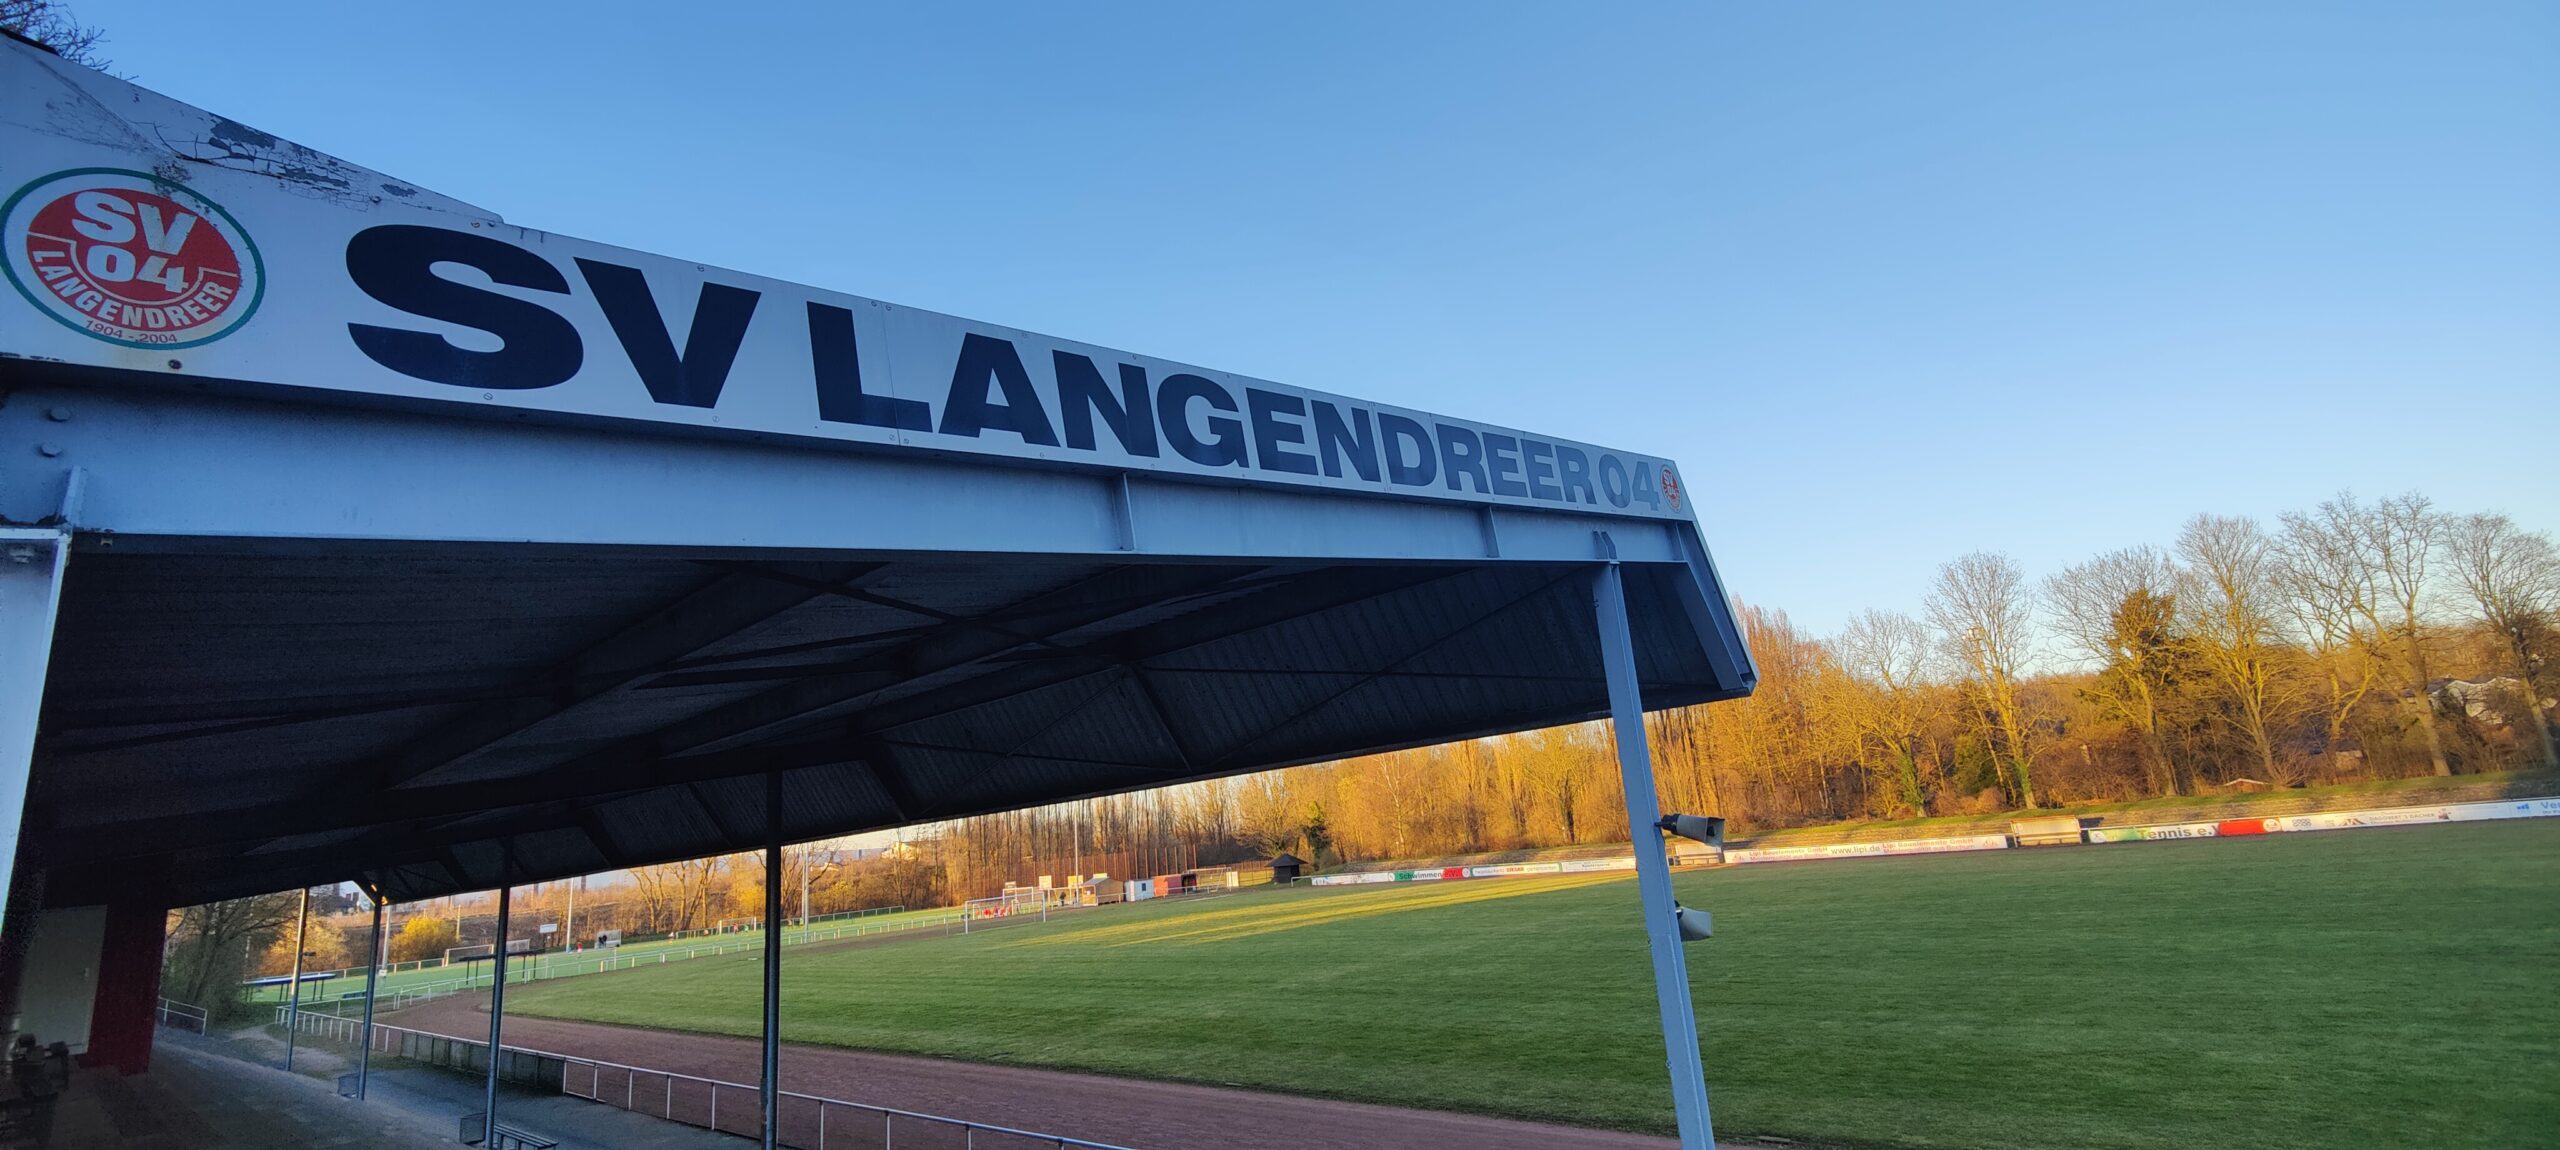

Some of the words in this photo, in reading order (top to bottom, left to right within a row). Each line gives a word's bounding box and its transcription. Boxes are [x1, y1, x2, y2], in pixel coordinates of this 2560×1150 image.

[72, 190, 198, 256] SV
[86, 244, 189, 293] 04
[32, 249, 233, 329] LANGENDREER
[86, 319, 123, 339] 1904
[138, 332, 177, 344] 2004
[346, 224, 762, 408] SV
[806, 301, 1598, 504] LANGENDREER
[1599, 453, 1661, 512] 04
[1830, 844, 1880, 856] www.lipi.de
[2137, 826, 2191, 840] Tennis
[1398, 870, 1441, 880] Schwimmen
